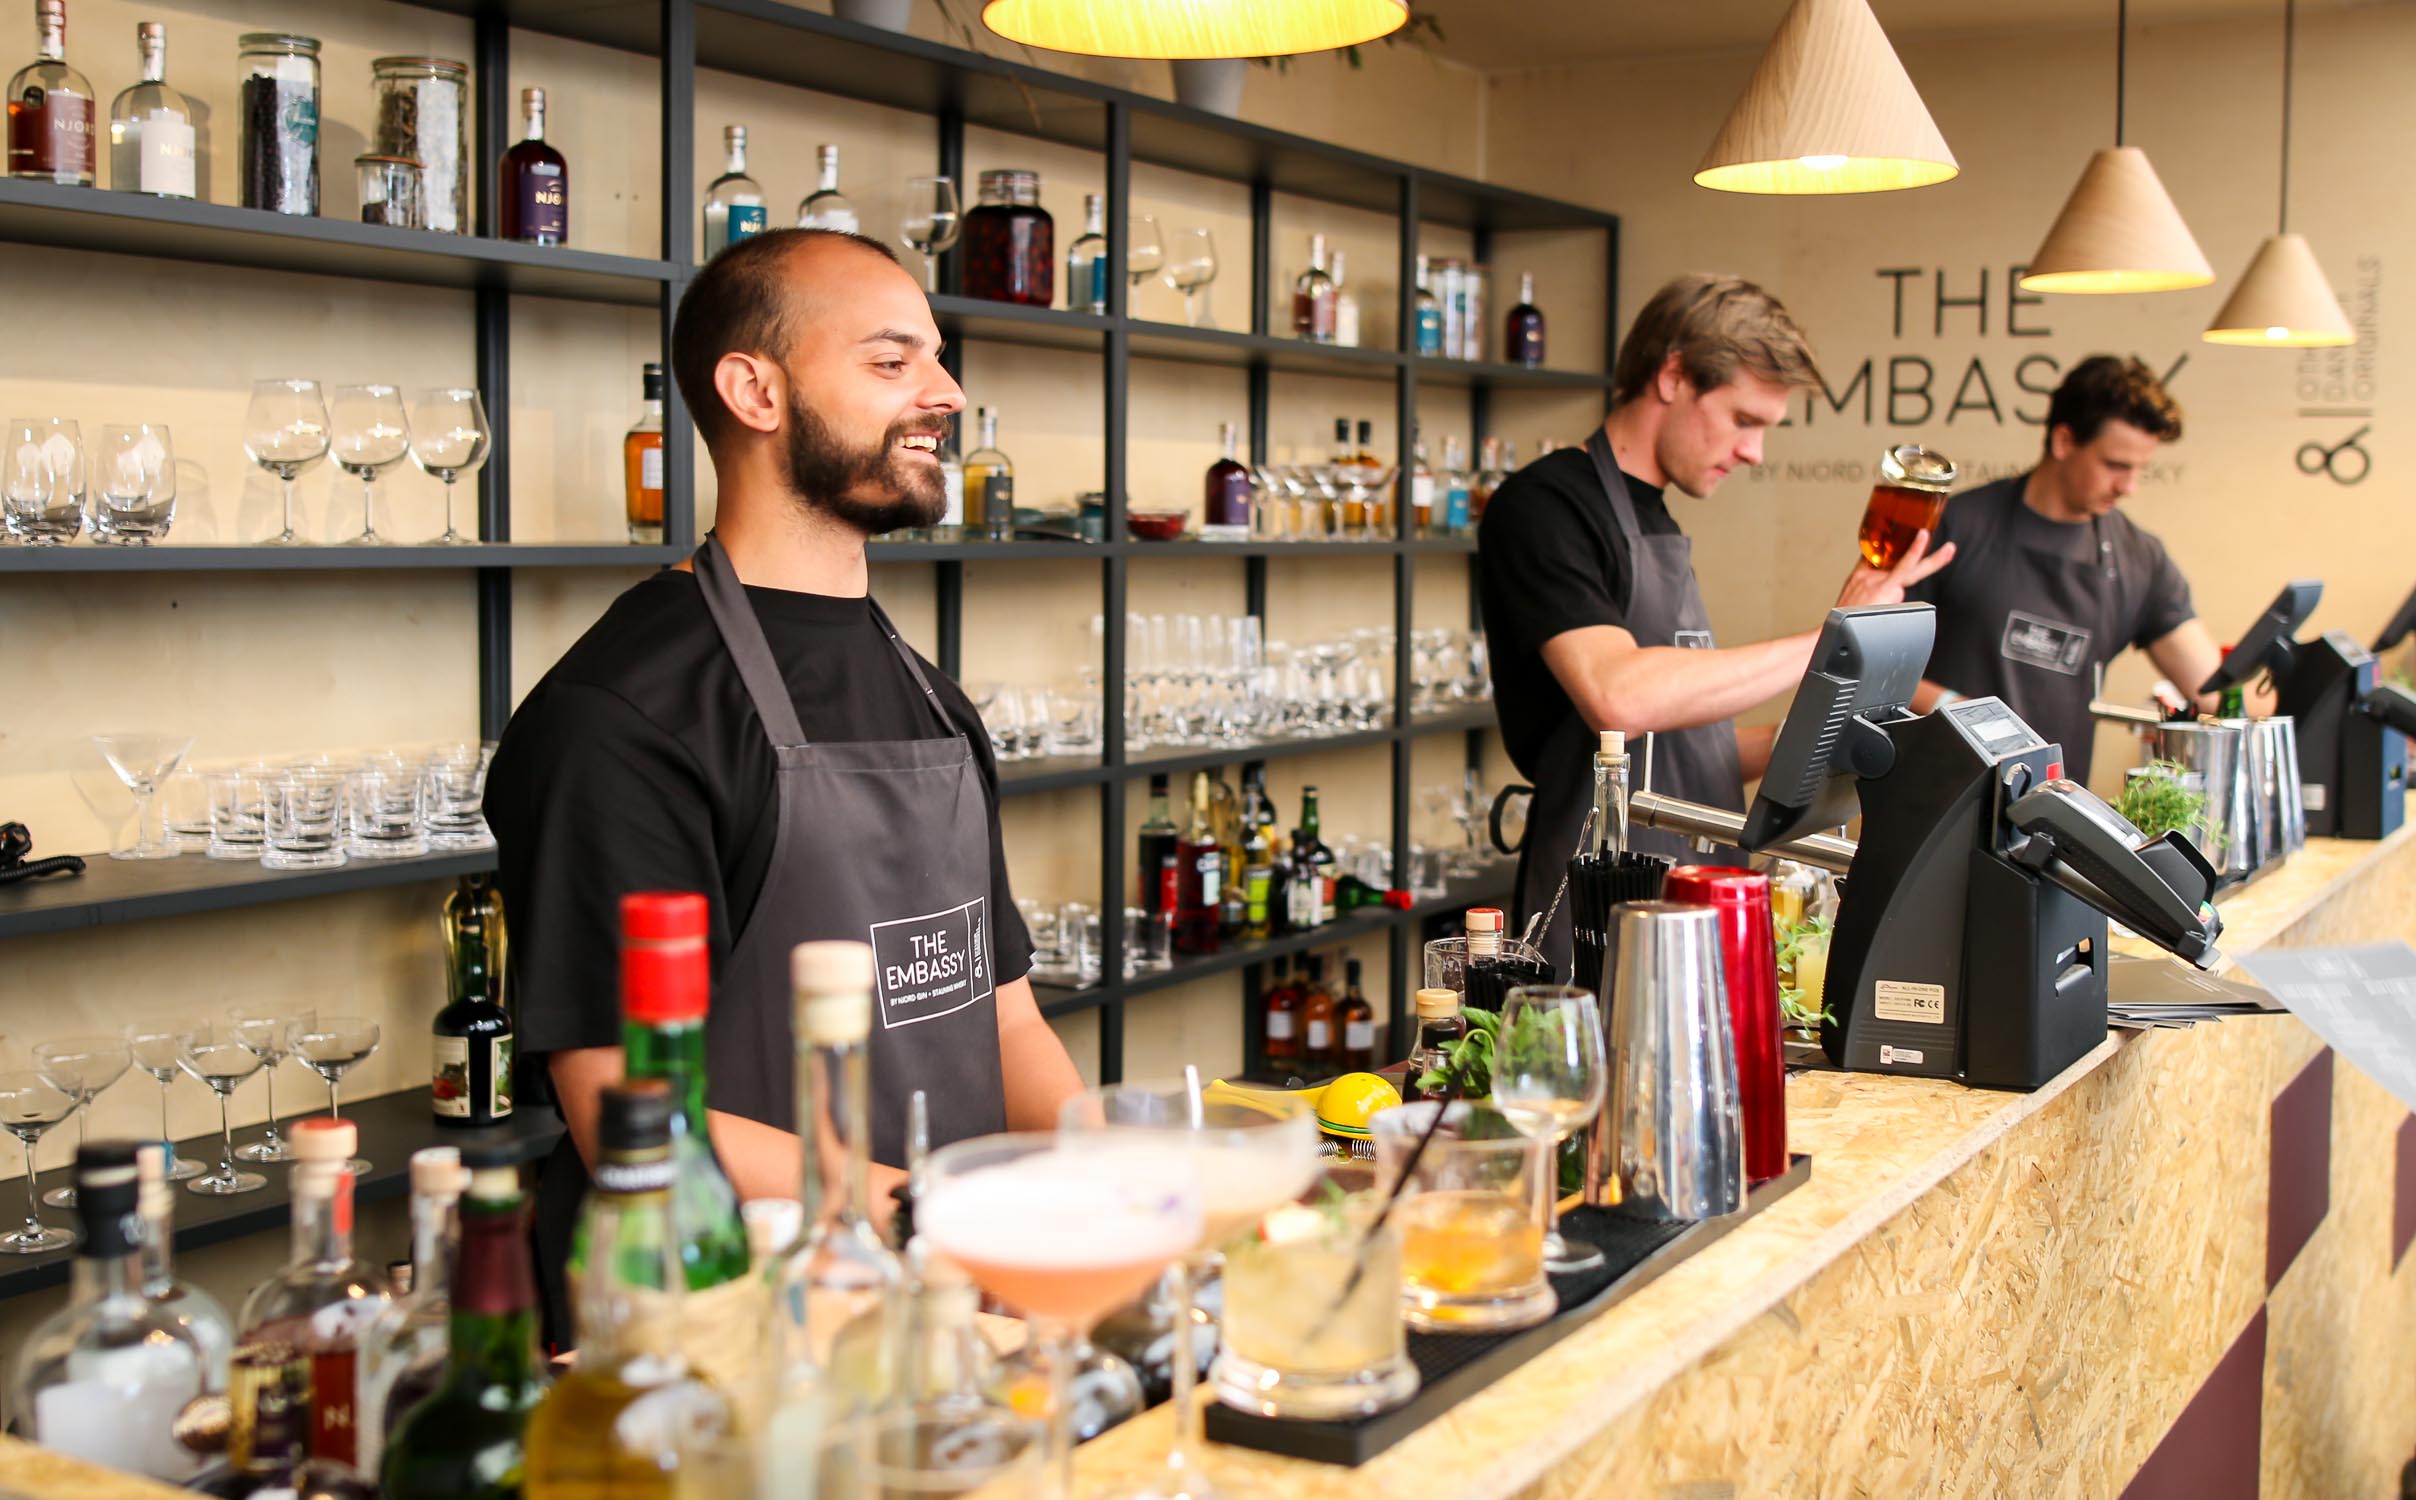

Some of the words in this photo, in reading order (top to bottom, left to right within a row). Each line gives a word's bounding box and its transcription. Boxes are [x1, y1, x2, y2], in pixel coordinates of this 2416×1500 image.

[1876, 265, 2053, 339] THE
[1774, 353, 2190, 427] MBAS
[910, 930, 947, 959] THE
[886, 949, 966, 990] EMBASSY
[890, 998, 898, 1006] BY
